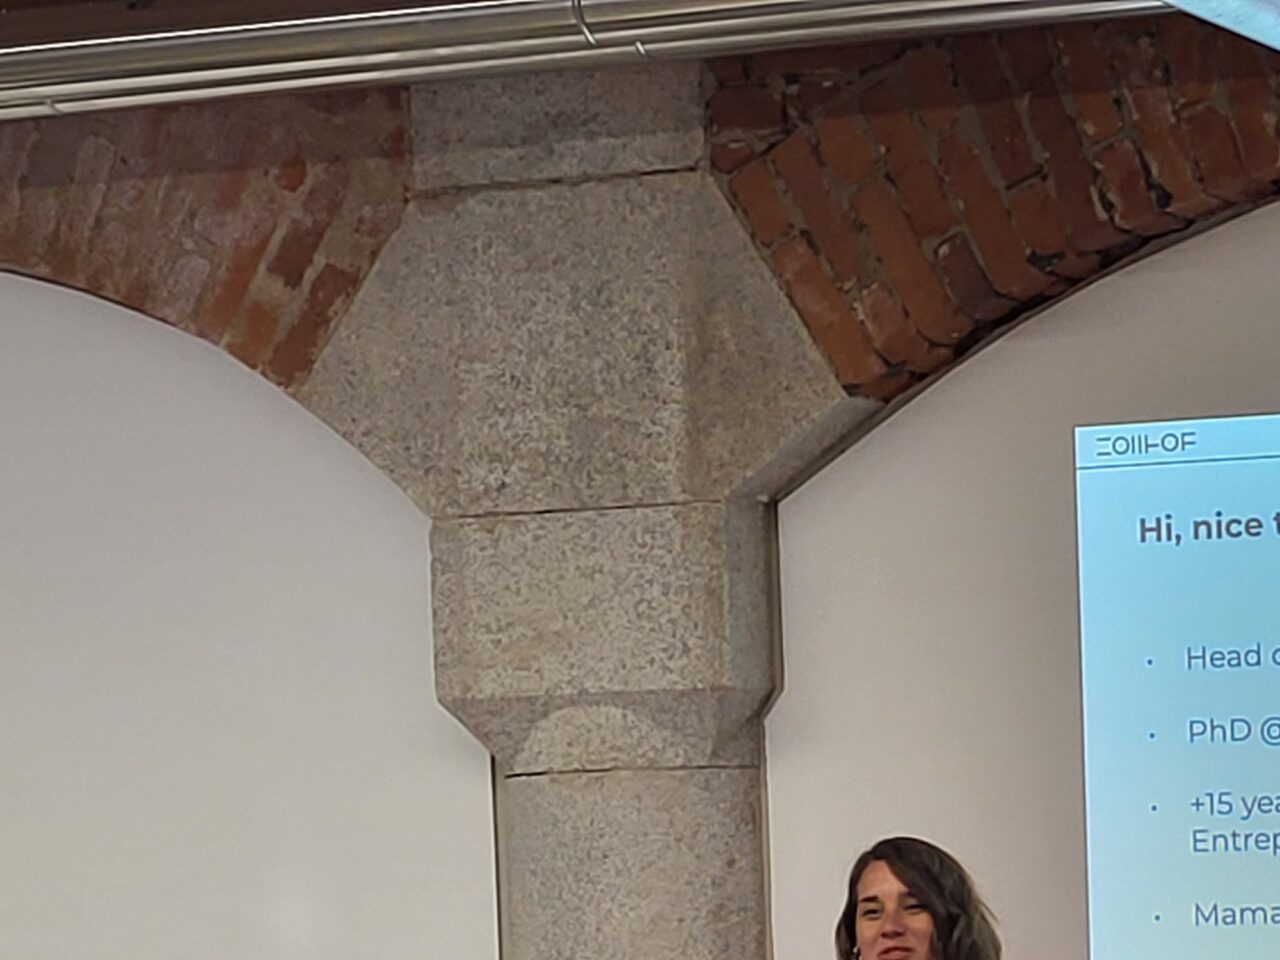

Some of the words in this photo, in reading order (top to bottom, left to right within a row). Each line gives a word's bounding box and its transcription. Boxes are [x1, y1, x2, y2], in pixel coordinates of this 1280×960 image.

[1138, 517, 1182, 546] Hi,
[1193, 510, 1264, 540] nice
[1186, 642, 1262, 670] Head
[1188, 718, 1252, 743] PhD
[1190, 791, 1232, 816] +15
